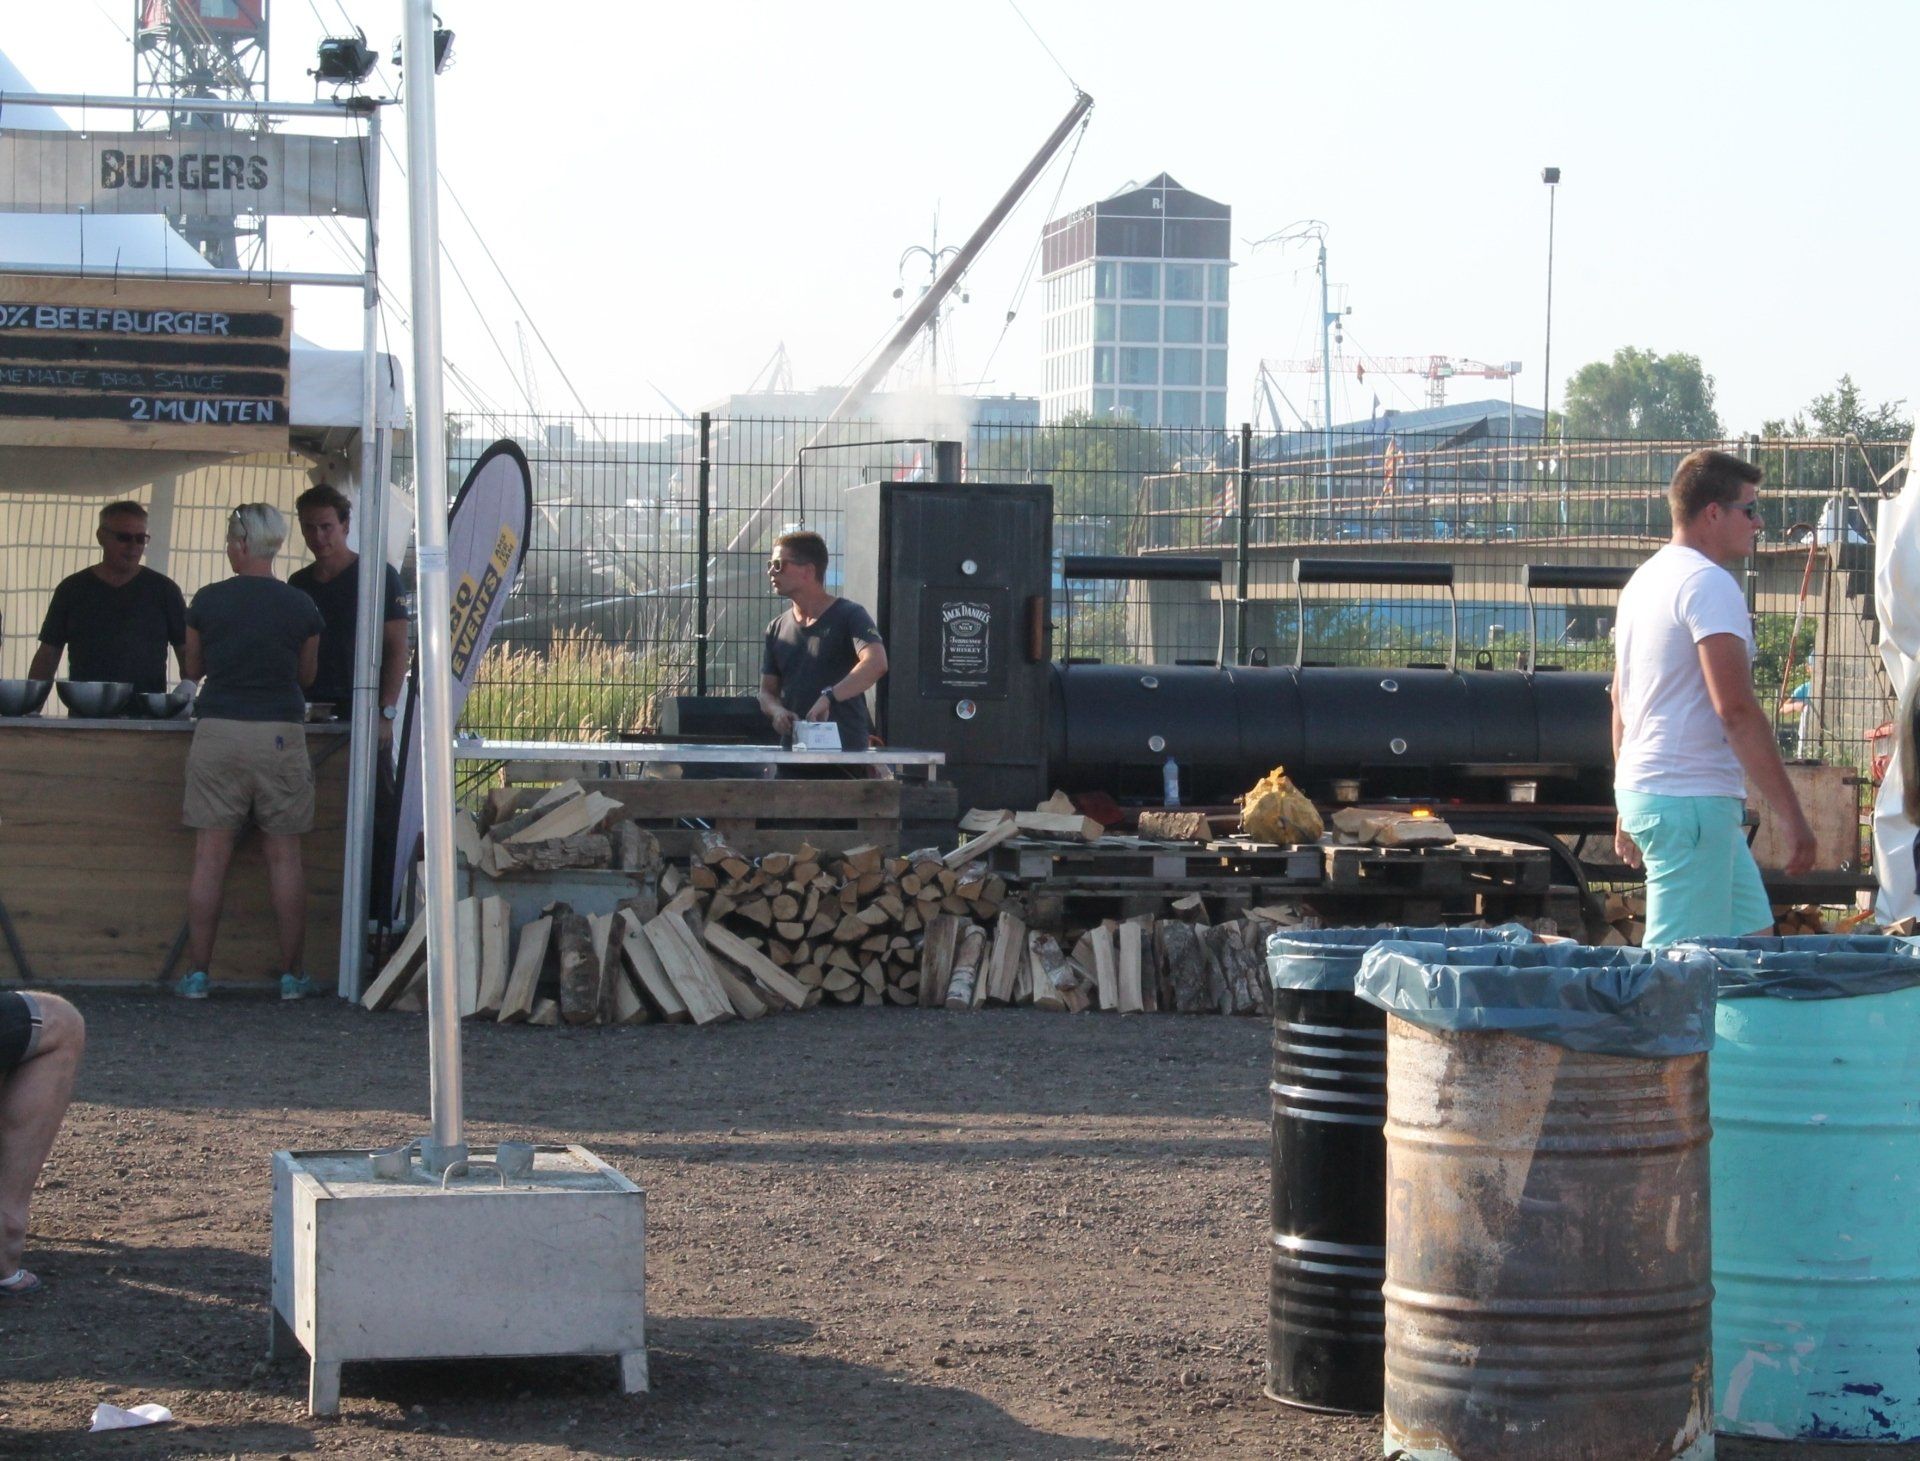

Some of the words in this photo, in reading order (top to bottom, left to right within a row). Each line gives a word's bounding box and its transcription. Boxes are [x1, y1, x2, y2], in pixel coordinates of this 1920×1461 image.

[102, 149, 268, 190] BURGERS
[35, 306, 230, 336] BEEFBURGER
[99, 371, 146, 386] BBQ
[154, 372, 226, 390] SAUCE
[129, 397, 151, 420] 2
[154, 400, 274, 424] MUNTEN
[452, 572, 497, 675] EVENTS
